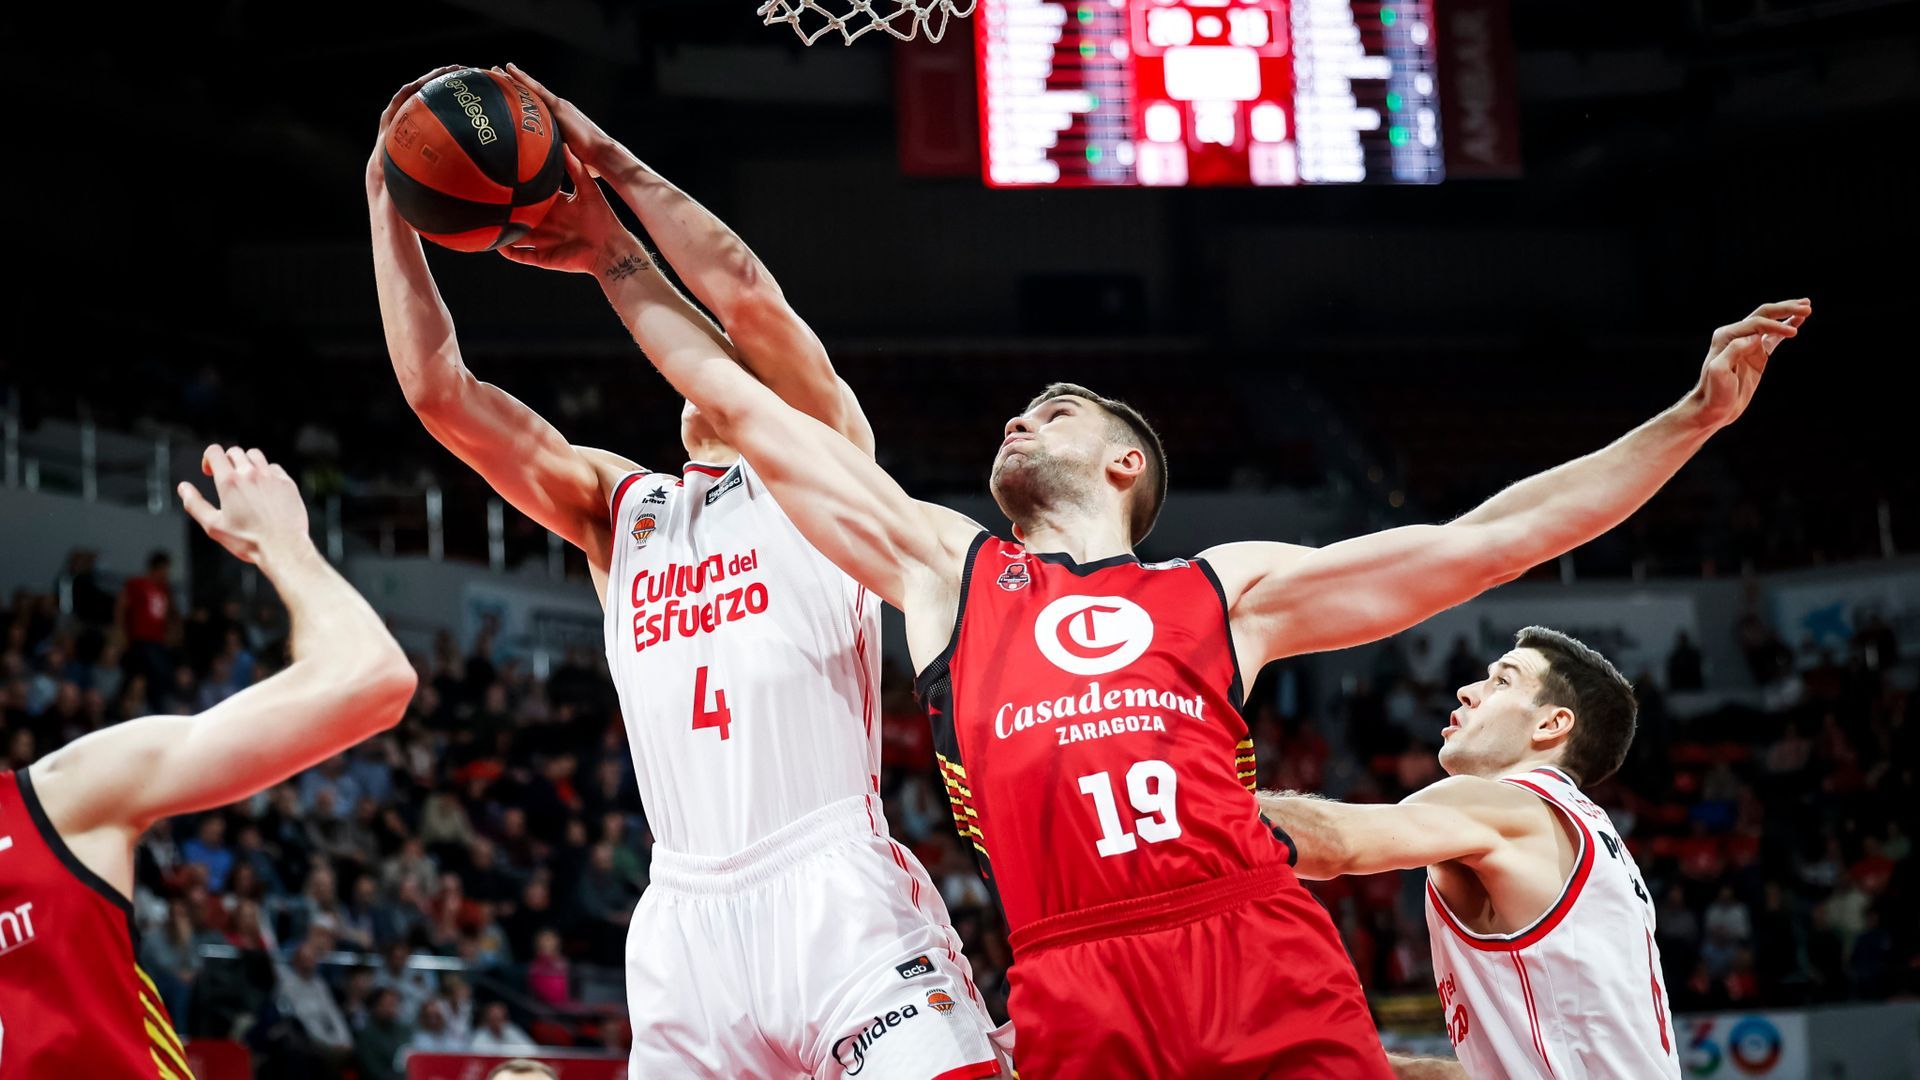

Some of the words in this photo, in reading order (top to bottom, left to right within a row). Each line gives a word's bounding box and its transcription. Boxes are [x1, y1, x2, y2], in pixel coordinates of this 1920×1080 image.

[444, 78, 498, 146] endesa
[728, 548, 758, 576] del
[633, 582, 769, 653] Esfuerzo
[692, 666, 732, 741] 4
[995, 681, 1206, 739] Casademont
[1055, 714, 1166, 746] ZARAGOZA
[1077, 760, 1182, 858] 19
[902, 964, 927, 978] acb
[832, 1004, 919, 1076] Midea
